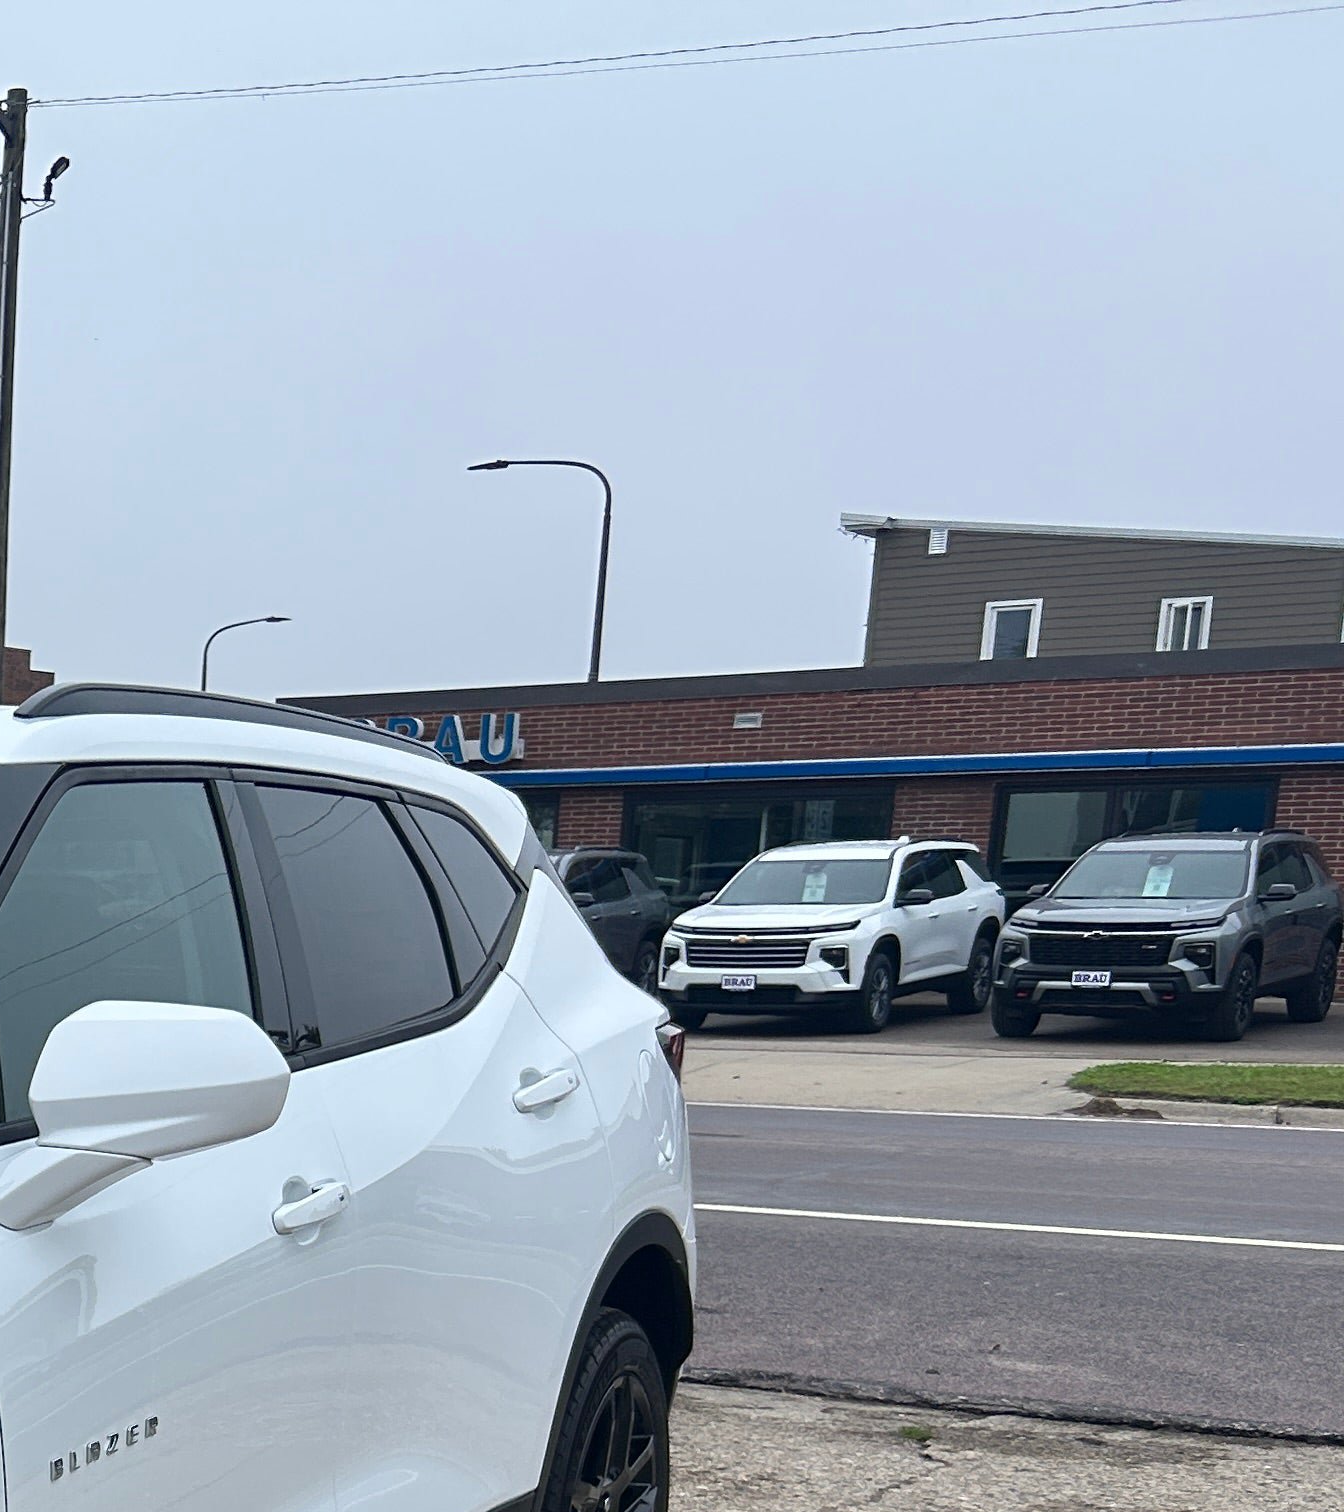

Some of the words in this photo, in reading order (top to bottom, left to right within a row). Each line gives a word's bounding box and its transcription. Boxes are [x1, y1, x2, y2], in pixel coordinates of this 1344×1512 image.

[723, 978, 753, 987] BRAU
[1073, 973, 1108, 983] BRAU
[48, 1414, 160, 1483] BLAZER
